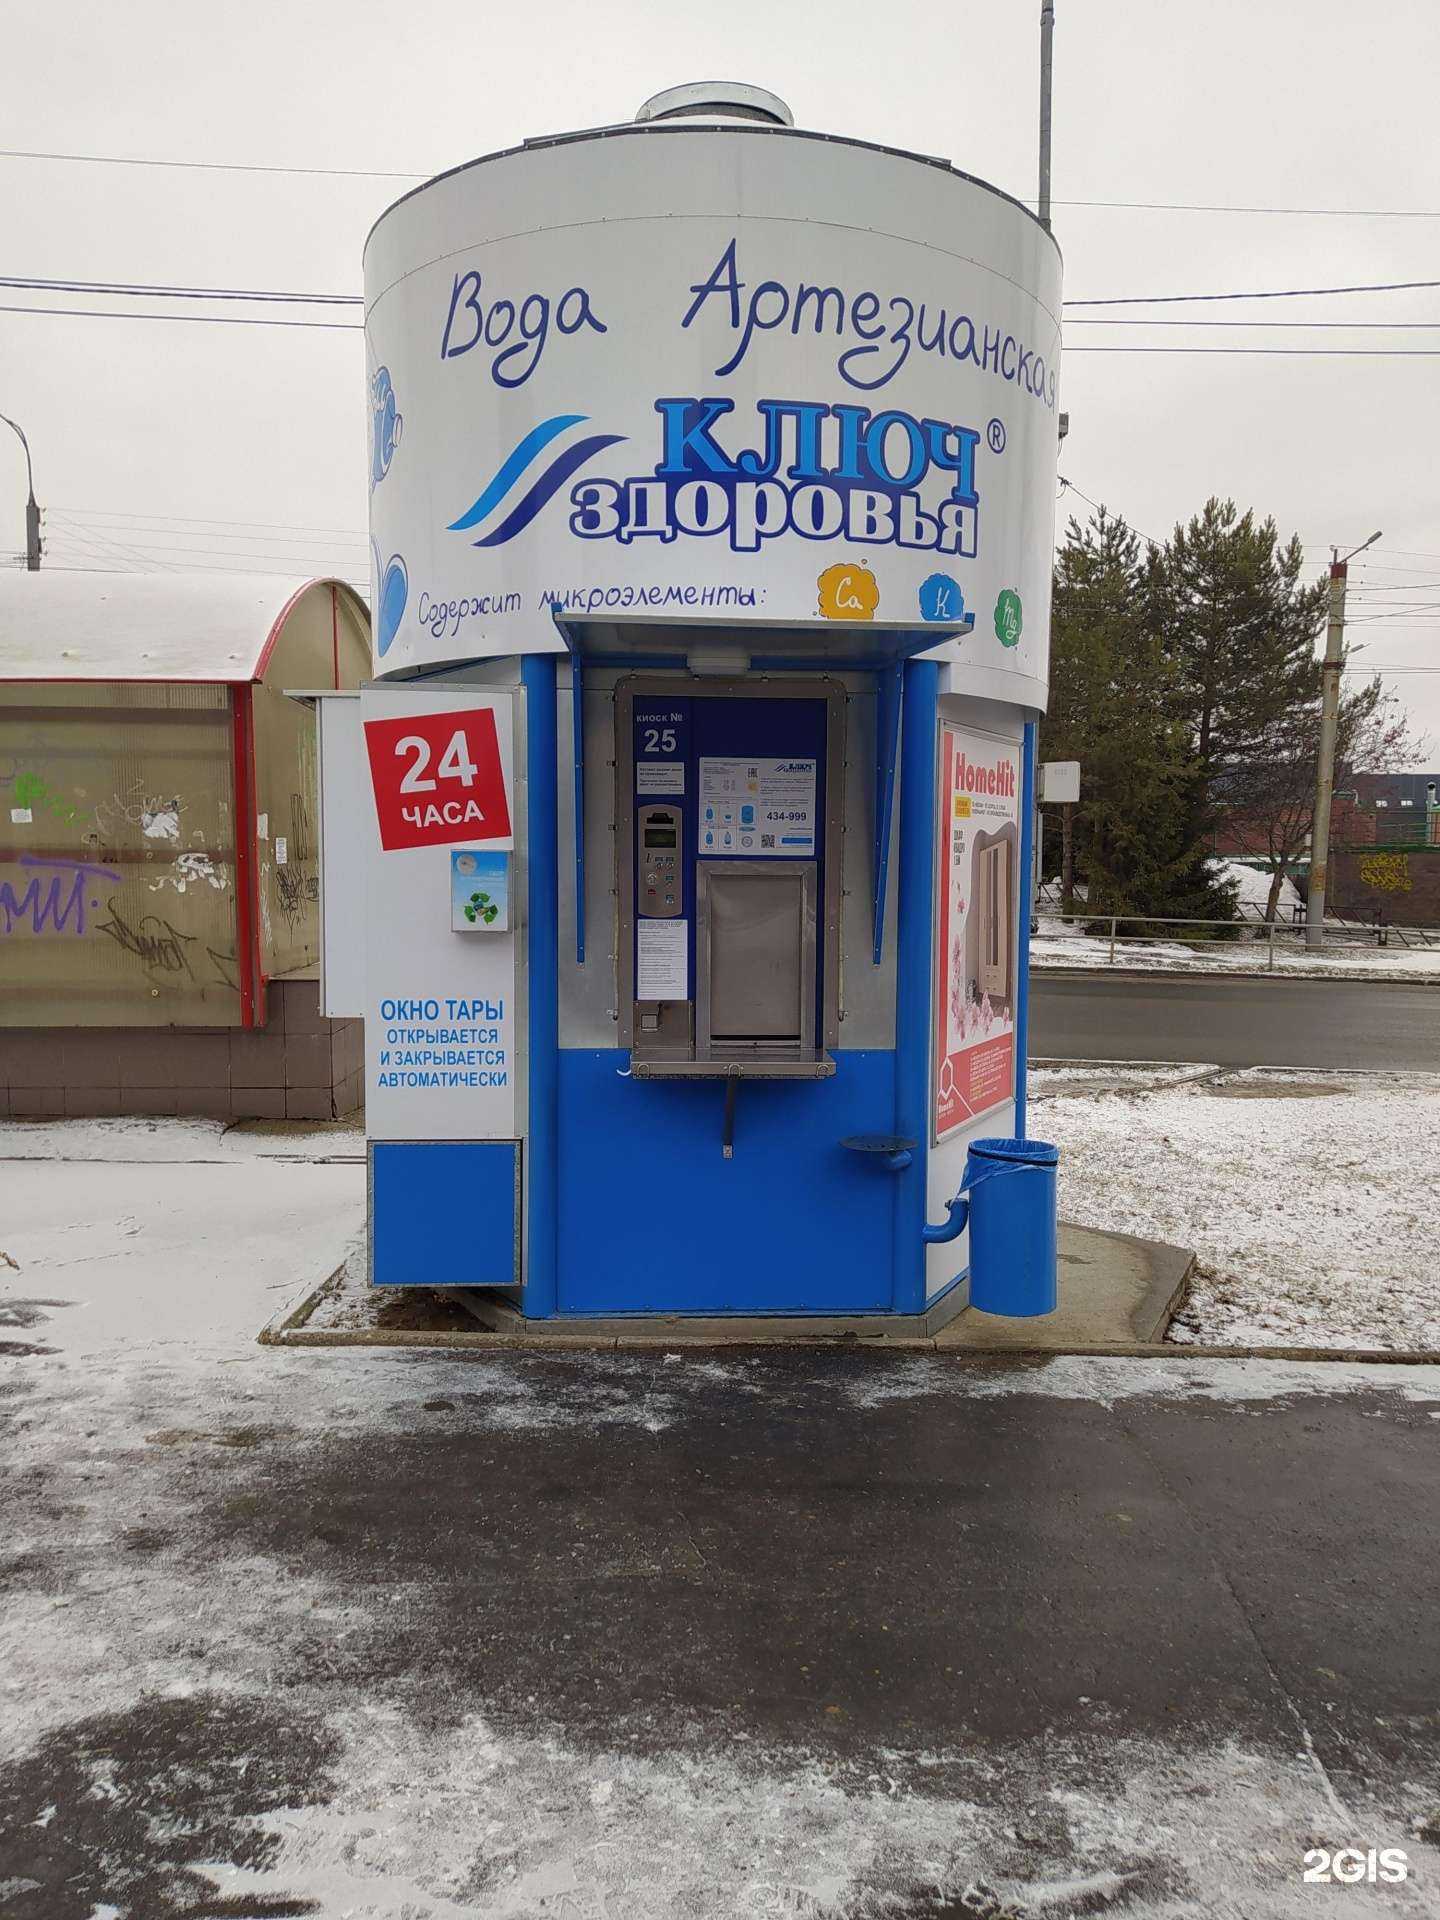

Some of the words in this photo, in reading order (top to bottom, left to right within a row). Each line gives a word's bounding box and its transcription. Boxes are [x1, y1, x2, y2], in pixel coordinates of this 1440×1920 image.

[441, 271, 607, 388] Вода
[681, 237, 1055, 416] Артезианская
[418, 591, 522, 637] Содержит
[538, 585, 768, 613] микроэлементы:
[644, 729, 677, 752] 25
[394, 730, 478, 793] 24
[955, 751, 1015, 797] HomeHit
[401, 800, 485, 828] ЧАСА
[766, 811, 807, 821] 434-999
[381, 999, 439, 1020] ОКНО
[445, 999, 503, 1020] ТАРЫ
[387, 1028, 498, 1044] ОТКРЫВАЕТСЯ
[380, 1050, 390, 1065] И
[394, 1050, 505, 1065] ЗАКРЫВАЕТСЯ
[377, 1071, 507, 1087] АВТОМАТИЧЕСКИ
